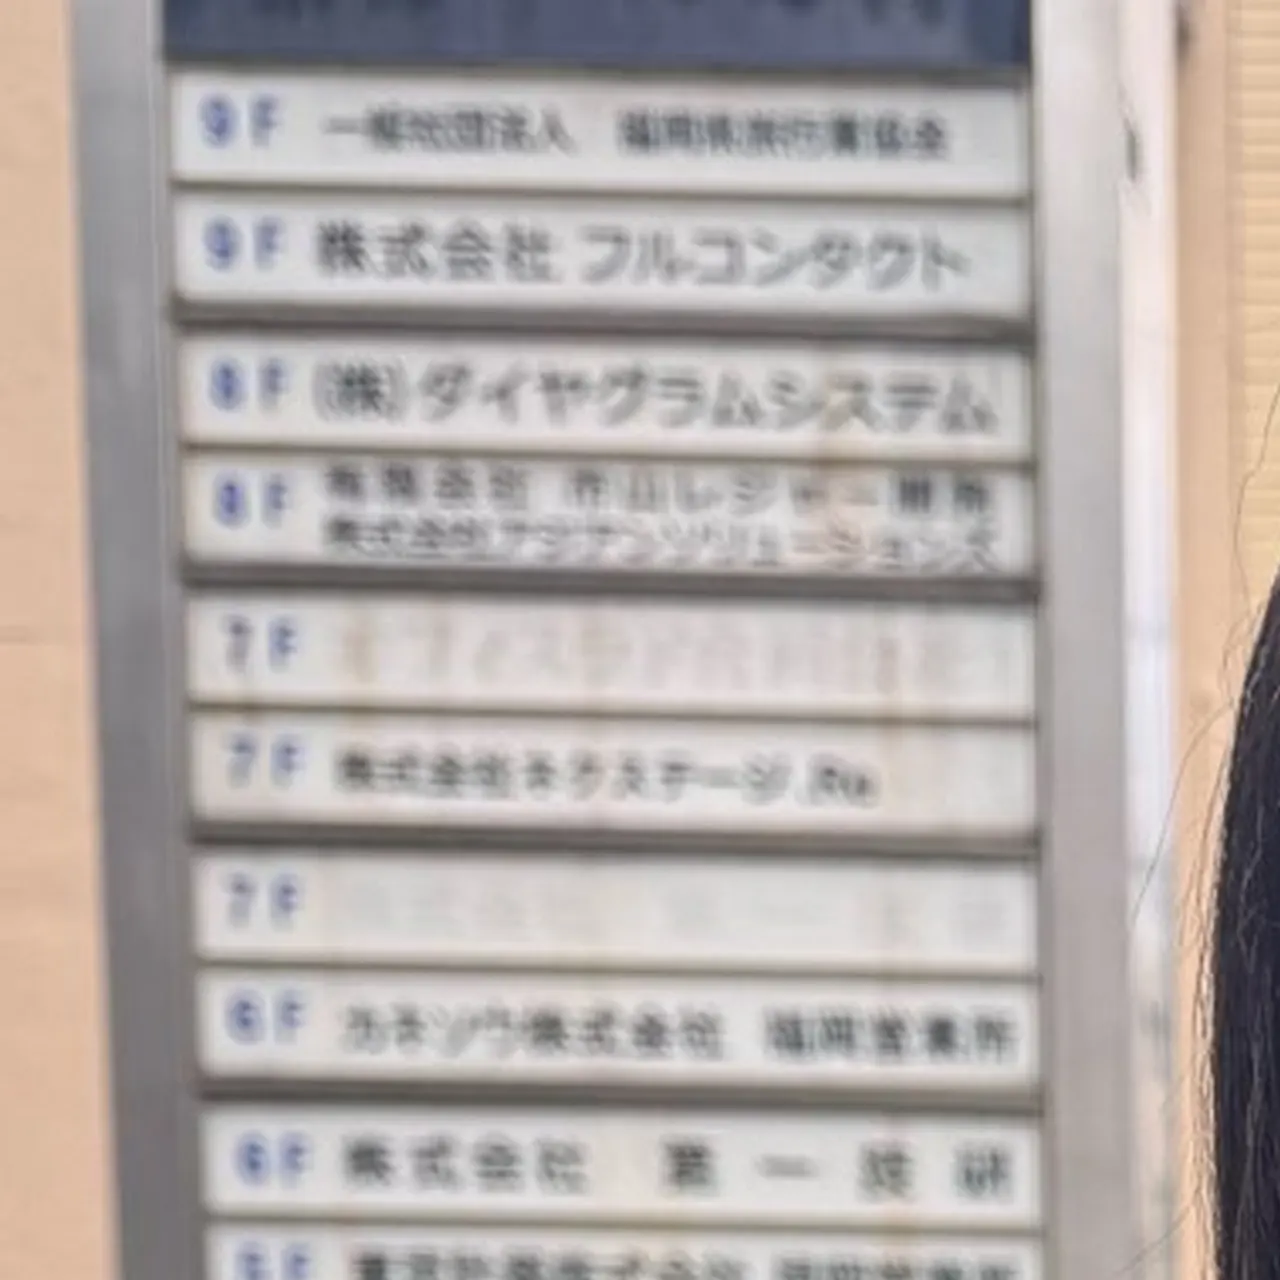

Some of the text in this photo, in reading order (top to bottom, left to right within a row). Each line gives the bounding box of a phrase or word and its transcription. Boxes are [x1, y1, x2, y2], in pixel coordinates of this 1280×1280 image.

[316, 218, 554, 280] 株式会社
[577, 224, 968, 293] フルコンタクト
[764, 1011, 1016, 1060] 福岡営業所
[341, 1135, 587, 1192] 株式会社
